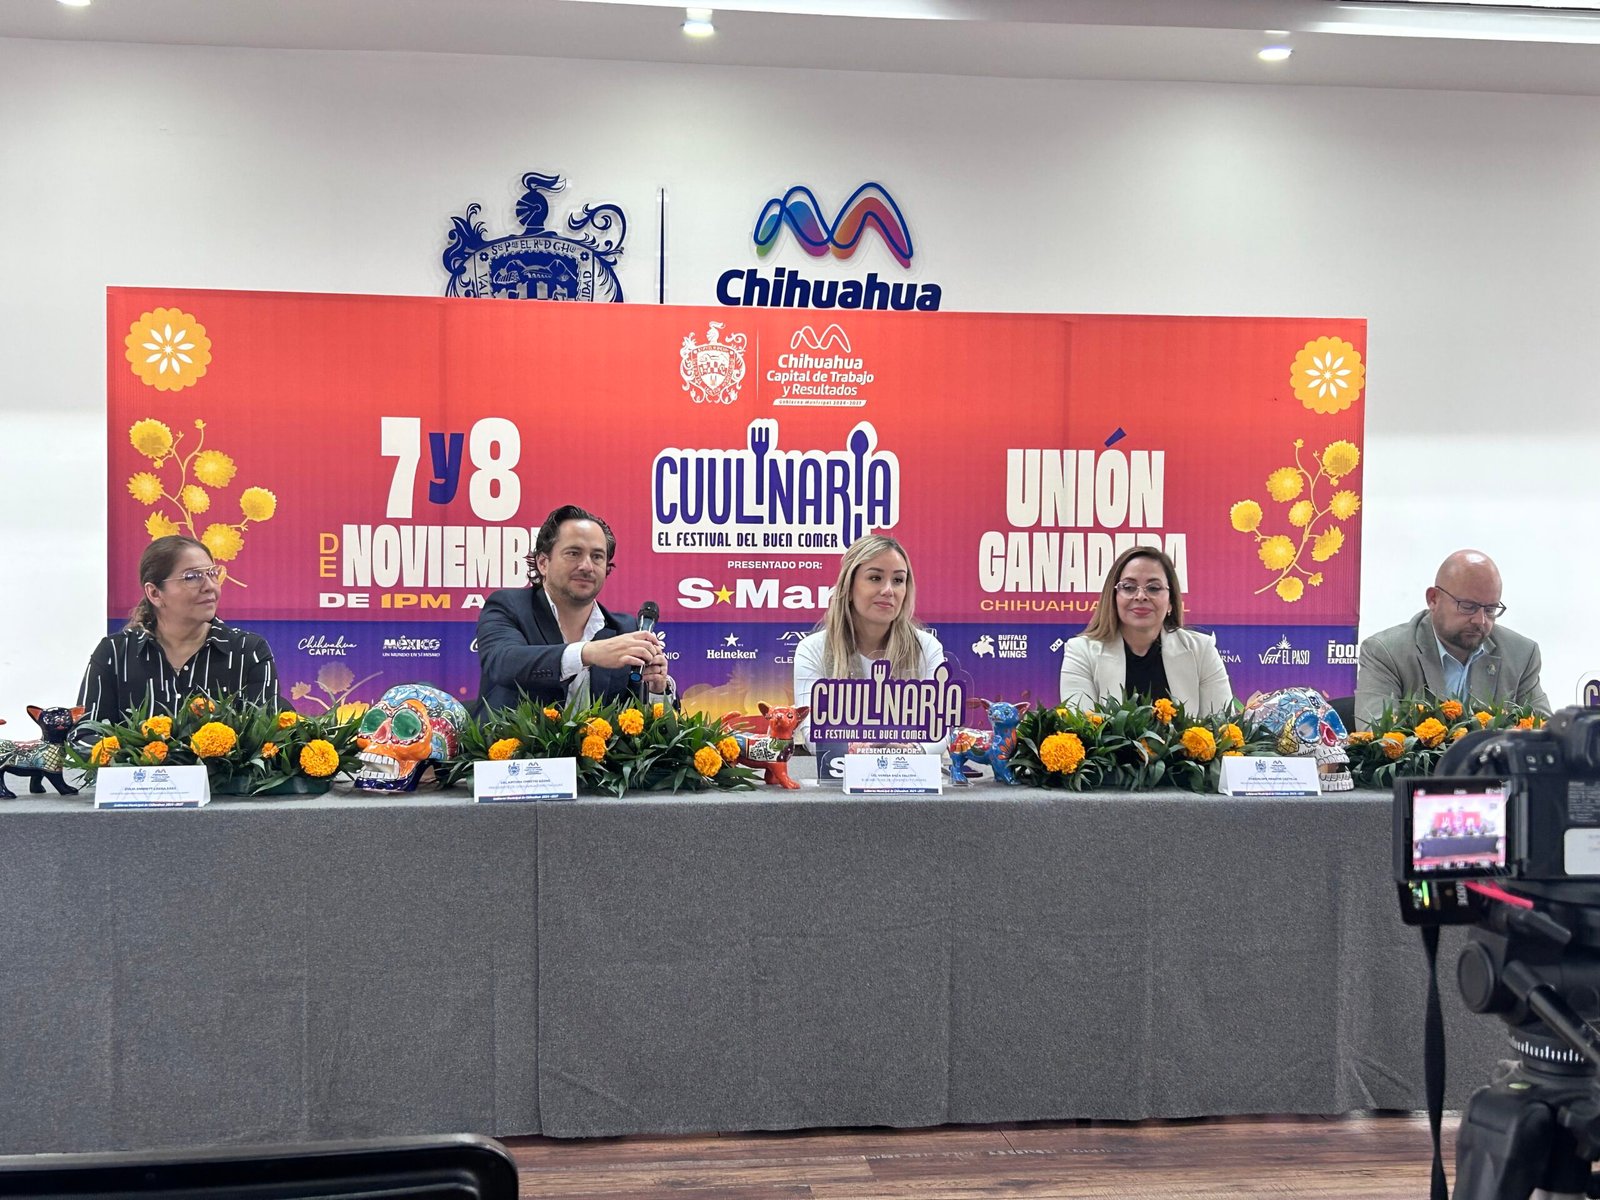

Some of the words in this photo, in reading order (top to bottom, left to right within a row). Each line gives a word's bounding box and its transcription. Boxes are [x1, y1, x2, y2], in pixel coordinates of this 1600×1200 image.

[716, 267, 942, 311] Chihuahua
[778, 354, 863, 369] Chihuahua
[767, 370, 810, 383] Capital
[812, 370, 828, 382] de
[829, 371, 874, 385] Trabajo
[782, 386, 791, 397] y
[792, 383, 857, 396] Resultados
[381, 417, 421, 518] 7
[428, 432, 464, 505] y
[469, 417, 521, 521] 8
[1006, 427, 1165, 528] UNIÓN
[655, 427, 891, 549] CUULINARIA
[658, 532, 671, 546] EL
[676, 532, 731, 547] FESTIVAL
[737, 533, 758, 547] DEL
[763, 533, 793, 547] BUEN
[798, 533, 838, 548] COMER
[343, 524, 538, 588] NOVIEMB
[727, 560, 796, 569] PRESENTADO
[799, 561, 822, 570] POR:
[319, 593, 369, 608] DE
[998, 641, 1028, 651] WILD
[774, 656, 794, 664] CLE
[1258, 647, 1281, 665] Visit
[1282, 650, 1290, 664] EL
[1291, 650, 1310, 665] PASO
[813, 665, 962, 741] CUULINARIA
[814, 730, 822, 739] EL
[825, 730, 859, 740] FESTIVAL
[863, 730, 876, 740] DEL
[879, 730, 898, 740] BUEN
[901, 730, 927, 740] COMER
